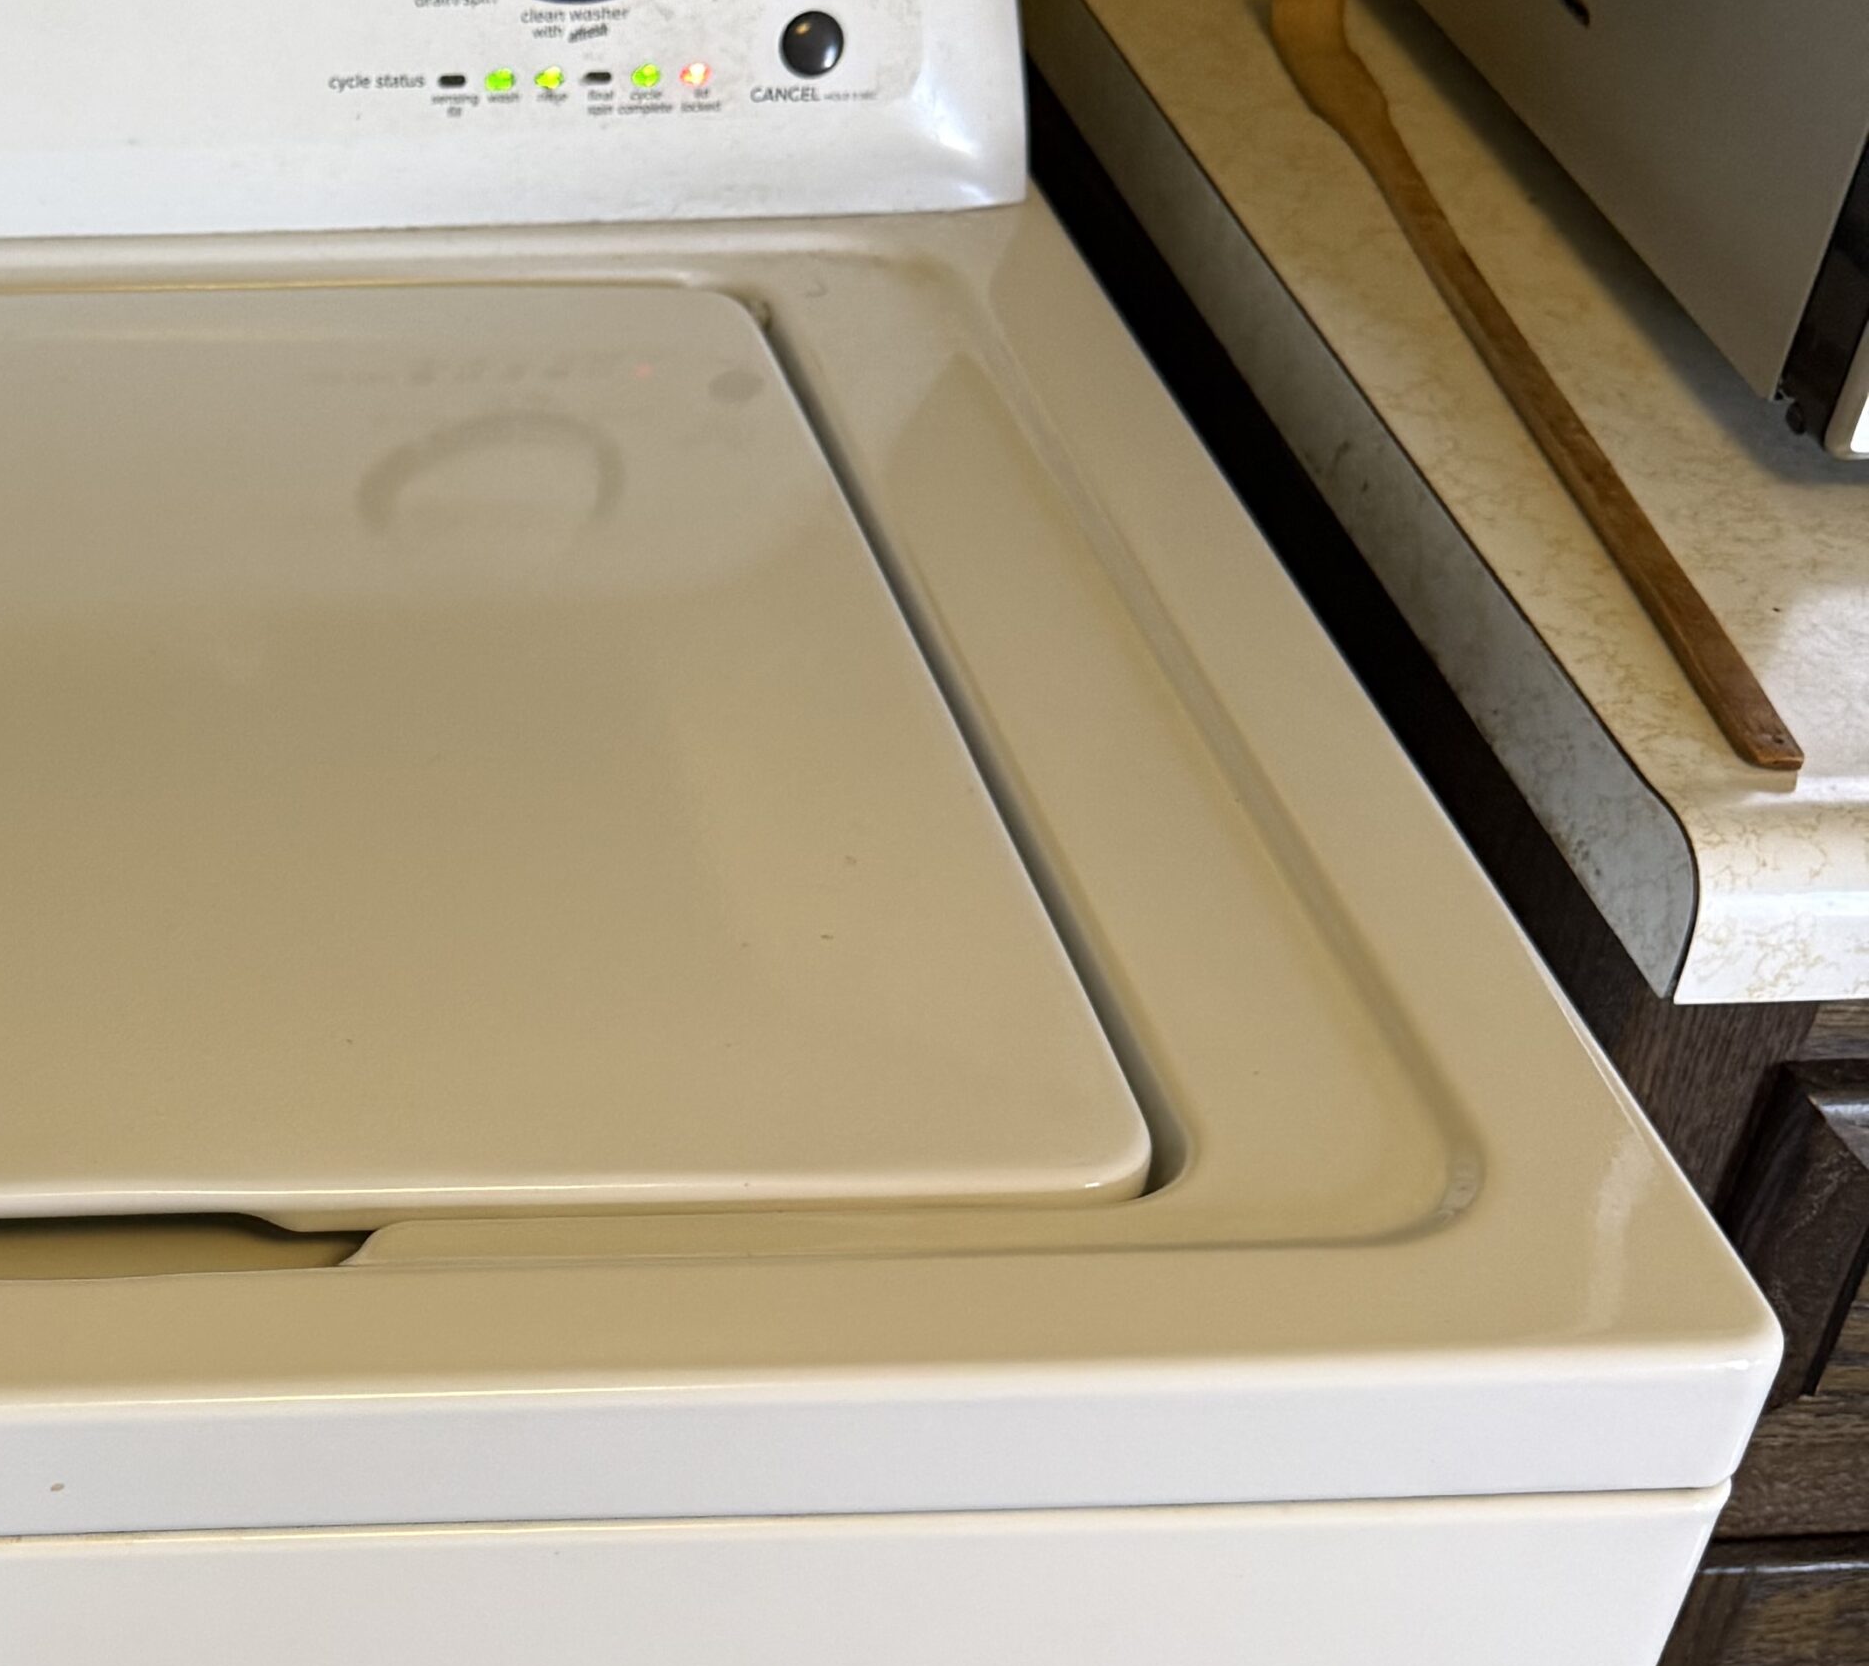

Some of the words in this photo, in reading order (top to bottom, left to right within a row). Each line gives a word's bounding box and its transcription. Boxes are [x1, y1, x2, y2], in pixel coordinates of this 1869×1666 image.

[521, 9, 565, 24] clean
[569, 7, 630, 22] washer
[533, 25, 563, 39] with
[328, 74, 371, 93] cycle
[375, 74, 426, 89] status
[750, 87, 820, 103] CANCEL
